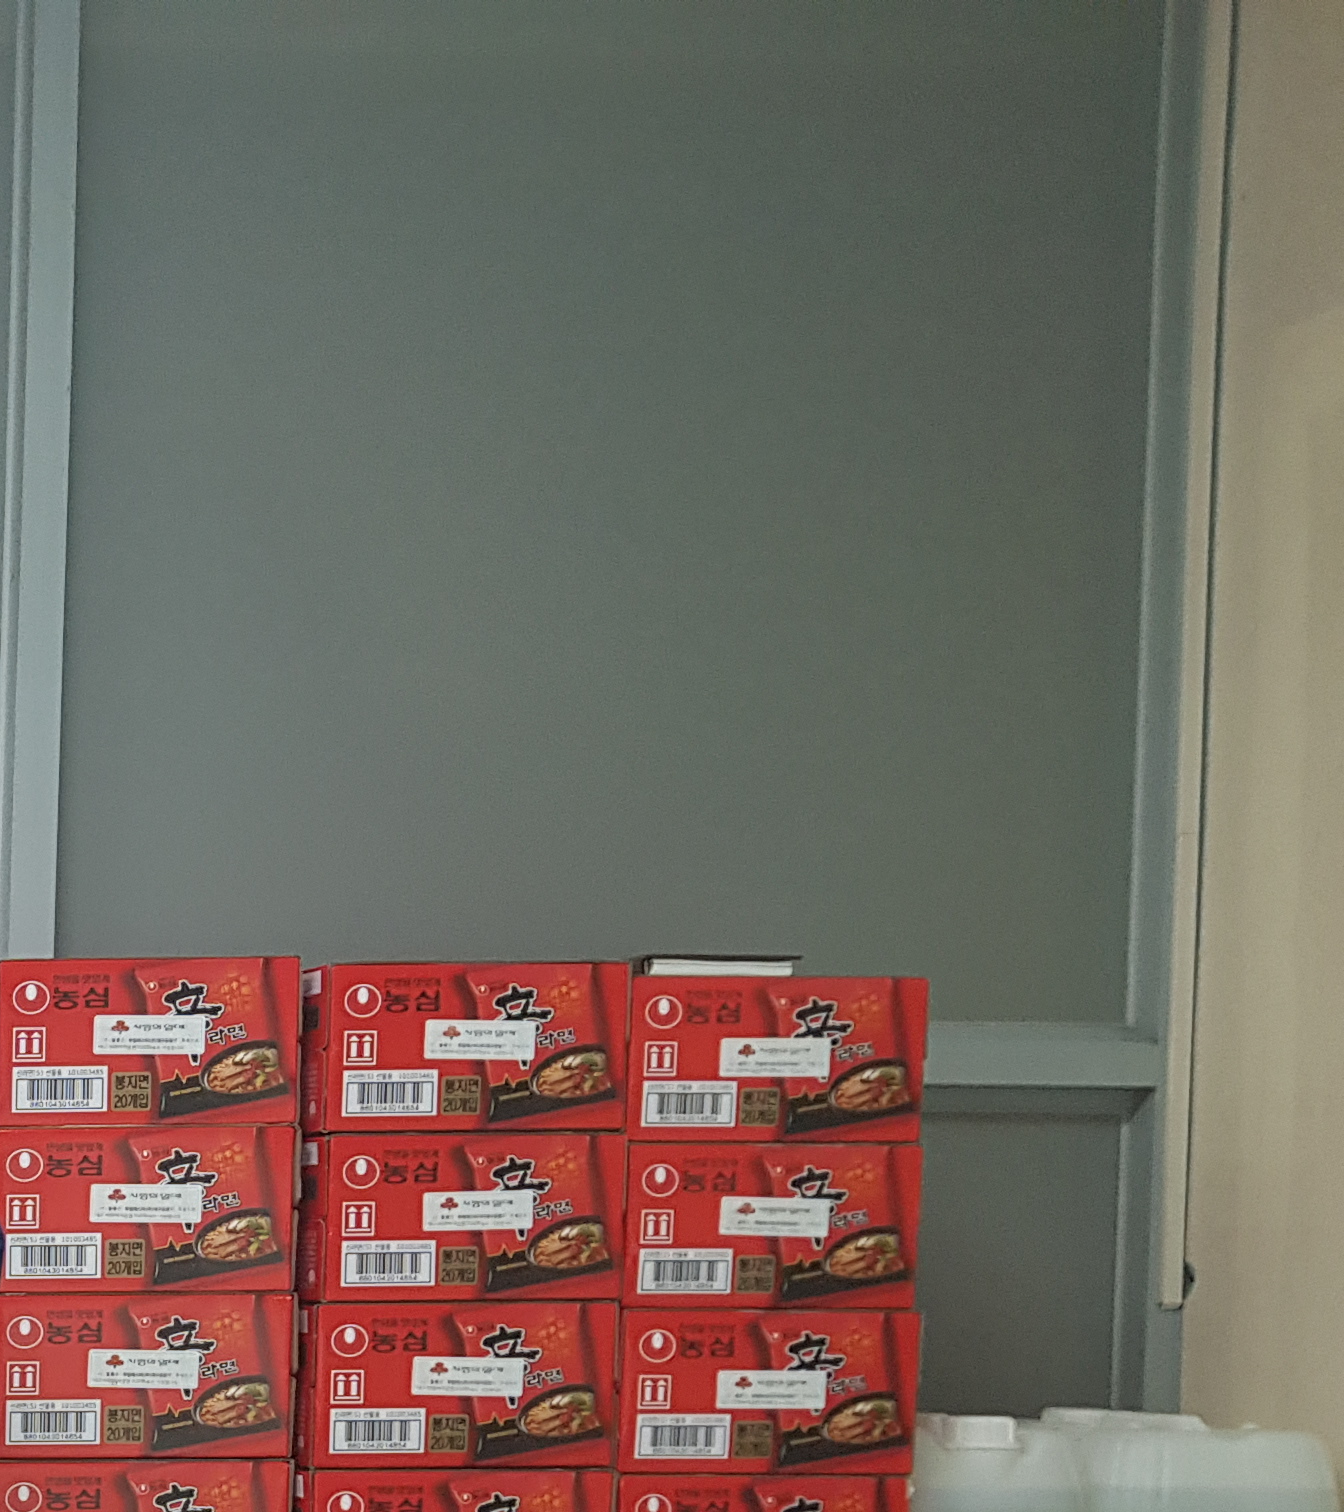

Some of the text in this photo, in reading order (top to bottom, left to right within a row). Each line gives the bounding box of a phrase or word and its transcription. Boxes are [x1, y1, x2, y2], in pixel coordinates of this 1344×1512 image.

[53, 987, 110, 1009] 농심
[208, 1025, 247, 1044] 라면
[115, 1076, 149, 1090] 봉지면
[114, 1094, 149, 1109] 20개입
[47, 1155, 104, 1177] 농심
[383, 1162, 439, 1184] 농심
[202, 1193, 241, 1212] 라면
[109, 1243, 143, 1257] 봉지면
[108, 1261, 143, 1276] 20개입
[47, 1322, 103, 1344] 농심
[371, 1330, 428, 1352] 농심
[45, 1489, 101, 1511] 농심
